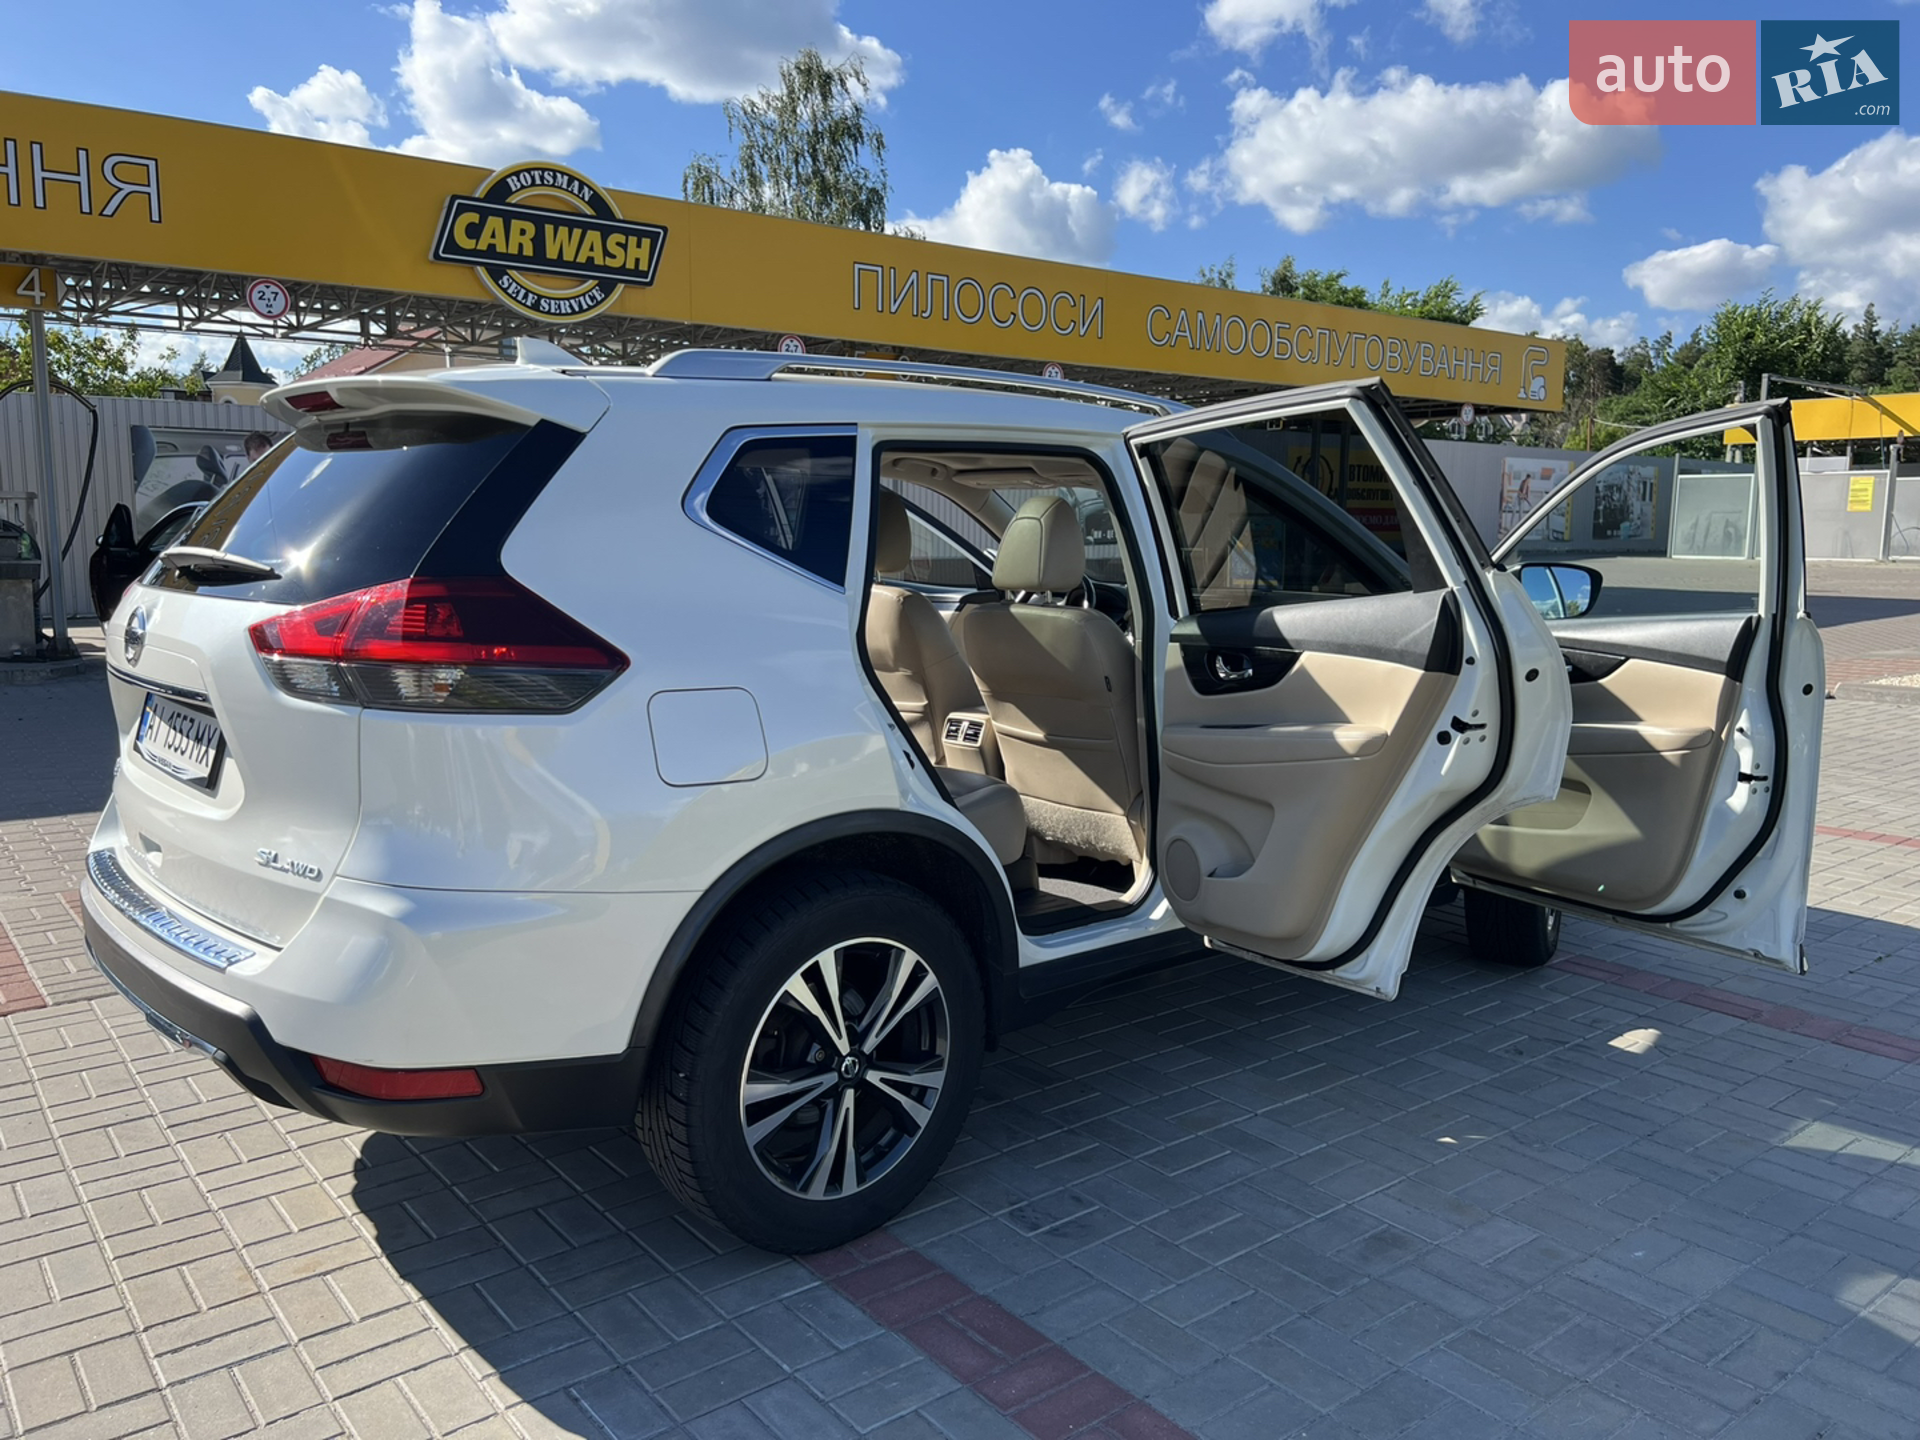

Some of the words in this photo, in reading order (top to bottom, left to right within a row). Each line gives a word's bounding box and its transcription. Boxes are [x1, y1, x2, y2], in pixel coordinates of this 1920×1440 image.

[506, 170, 594, 202] BOTSMAN
[453, 211, 537, 257] CAR
[544, 223, 652, 272] WASH
[16, 267, 46, 306] 4
[257, 290, 280, 303] 2,7
[498, 274, 539, 306] SELF
[539, 285, 605, 314] SERVICE
[852, 261, 1104, 339] ПИЛОСОСИ
[1146, 304, 1503, 385] САМООБСЛУГОВУВАННЯ
[145, 703, 165, 743] AI
[189, 721, 218, 768] MX
